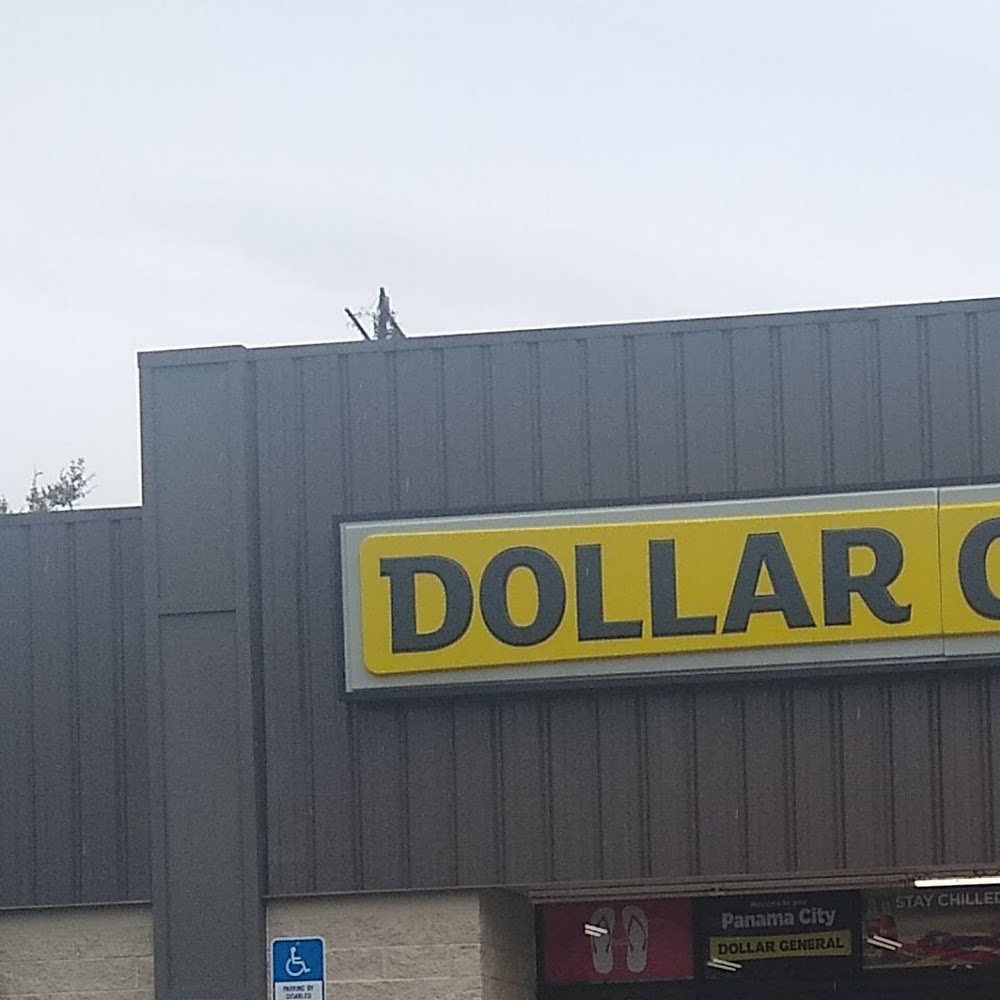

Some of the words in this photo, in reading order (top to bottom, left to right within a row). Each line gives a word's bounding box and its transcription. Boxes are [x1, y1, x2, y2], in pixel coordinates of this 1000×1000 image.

[379, 527, 912, 655] DOLLAR
[895, 895, 934, 909] STAY
[721, 911, 795, 930] Panama
[799, 906, 837, 927] City
[717, 940, 776, 956] DOLLAR
[779, 936, 845, 952] GENERAL
